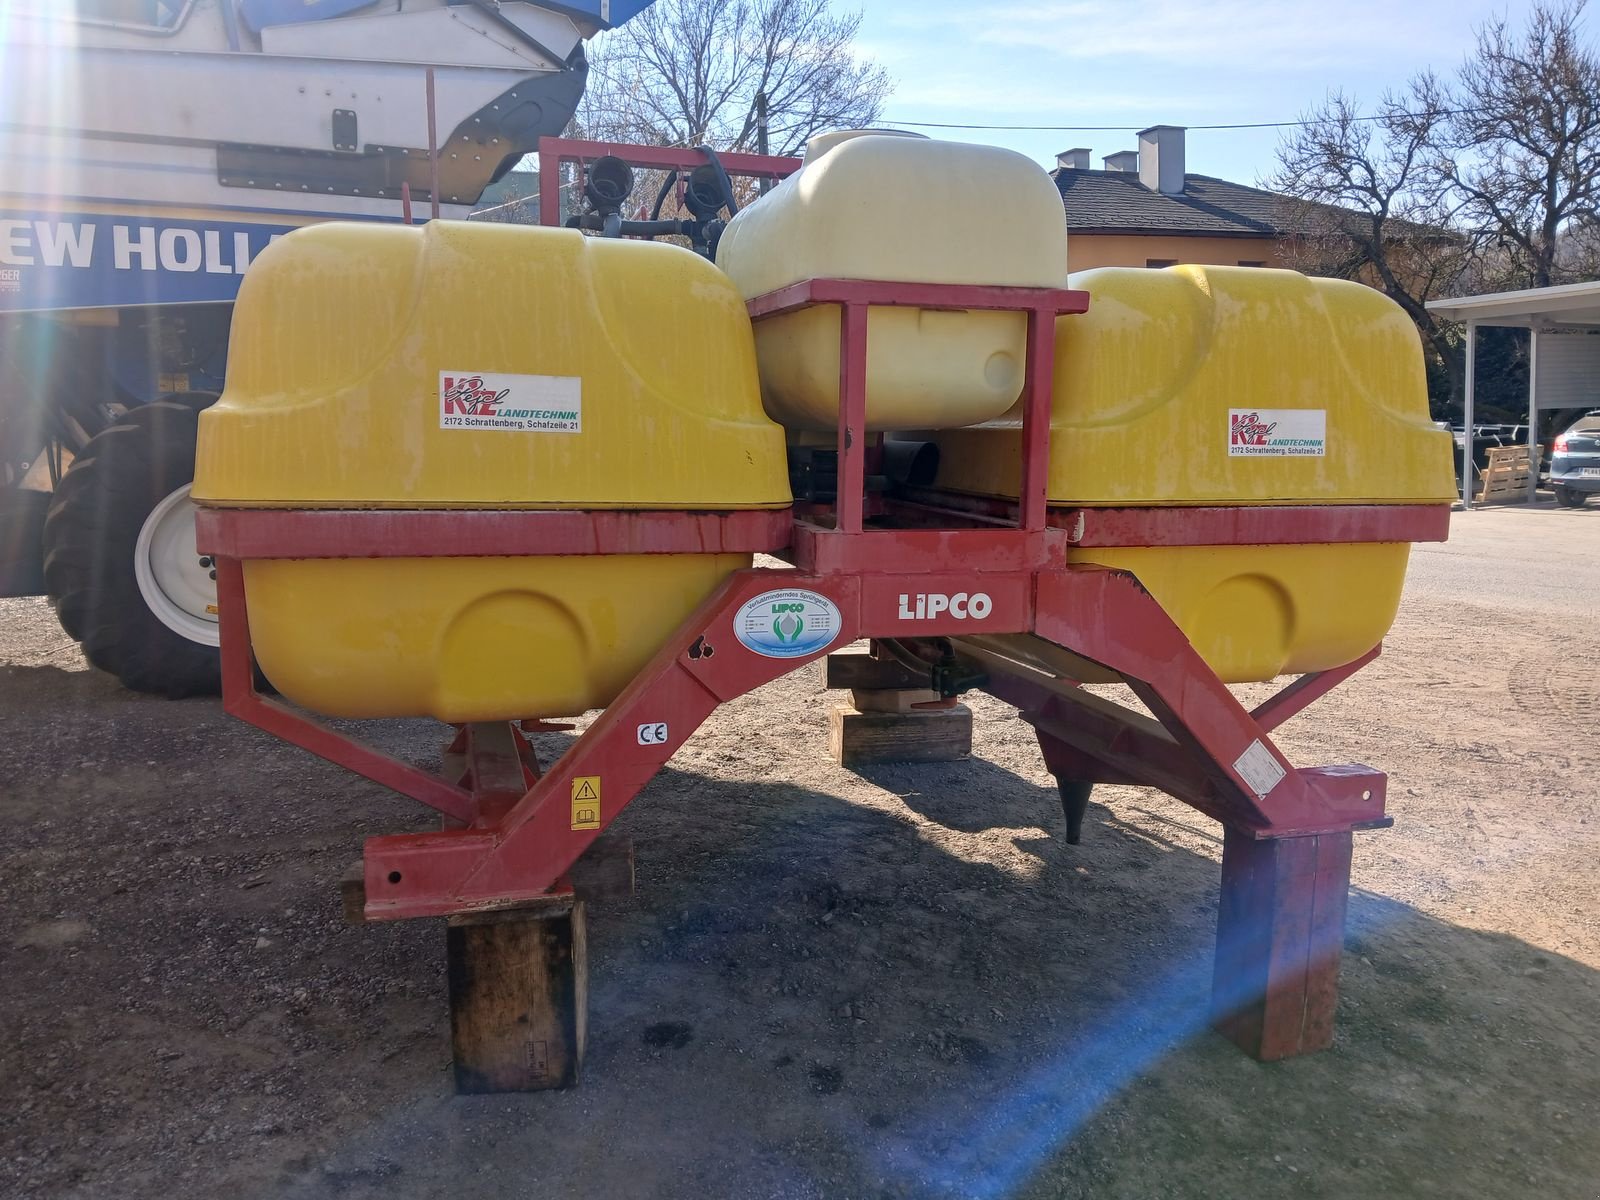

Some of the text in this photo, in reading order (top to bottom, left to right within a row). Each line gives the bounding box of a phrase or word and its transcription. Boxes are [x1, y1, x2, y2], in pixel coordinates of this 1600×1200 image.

[112, 224, 286, 275] HOLL
[497, 408, 578, 420] LANDTECHNIK
[444, 417, 578, 430] 2172 Schrattenberg, Schafzeile 21
[747, 592, 829, 610] Verlustminderndes Sprühgerät
[771, 603, 805, 614] LIPCO
[898, 592, 993, 620] LIPCO
[641, 724, 665, 742] CE
